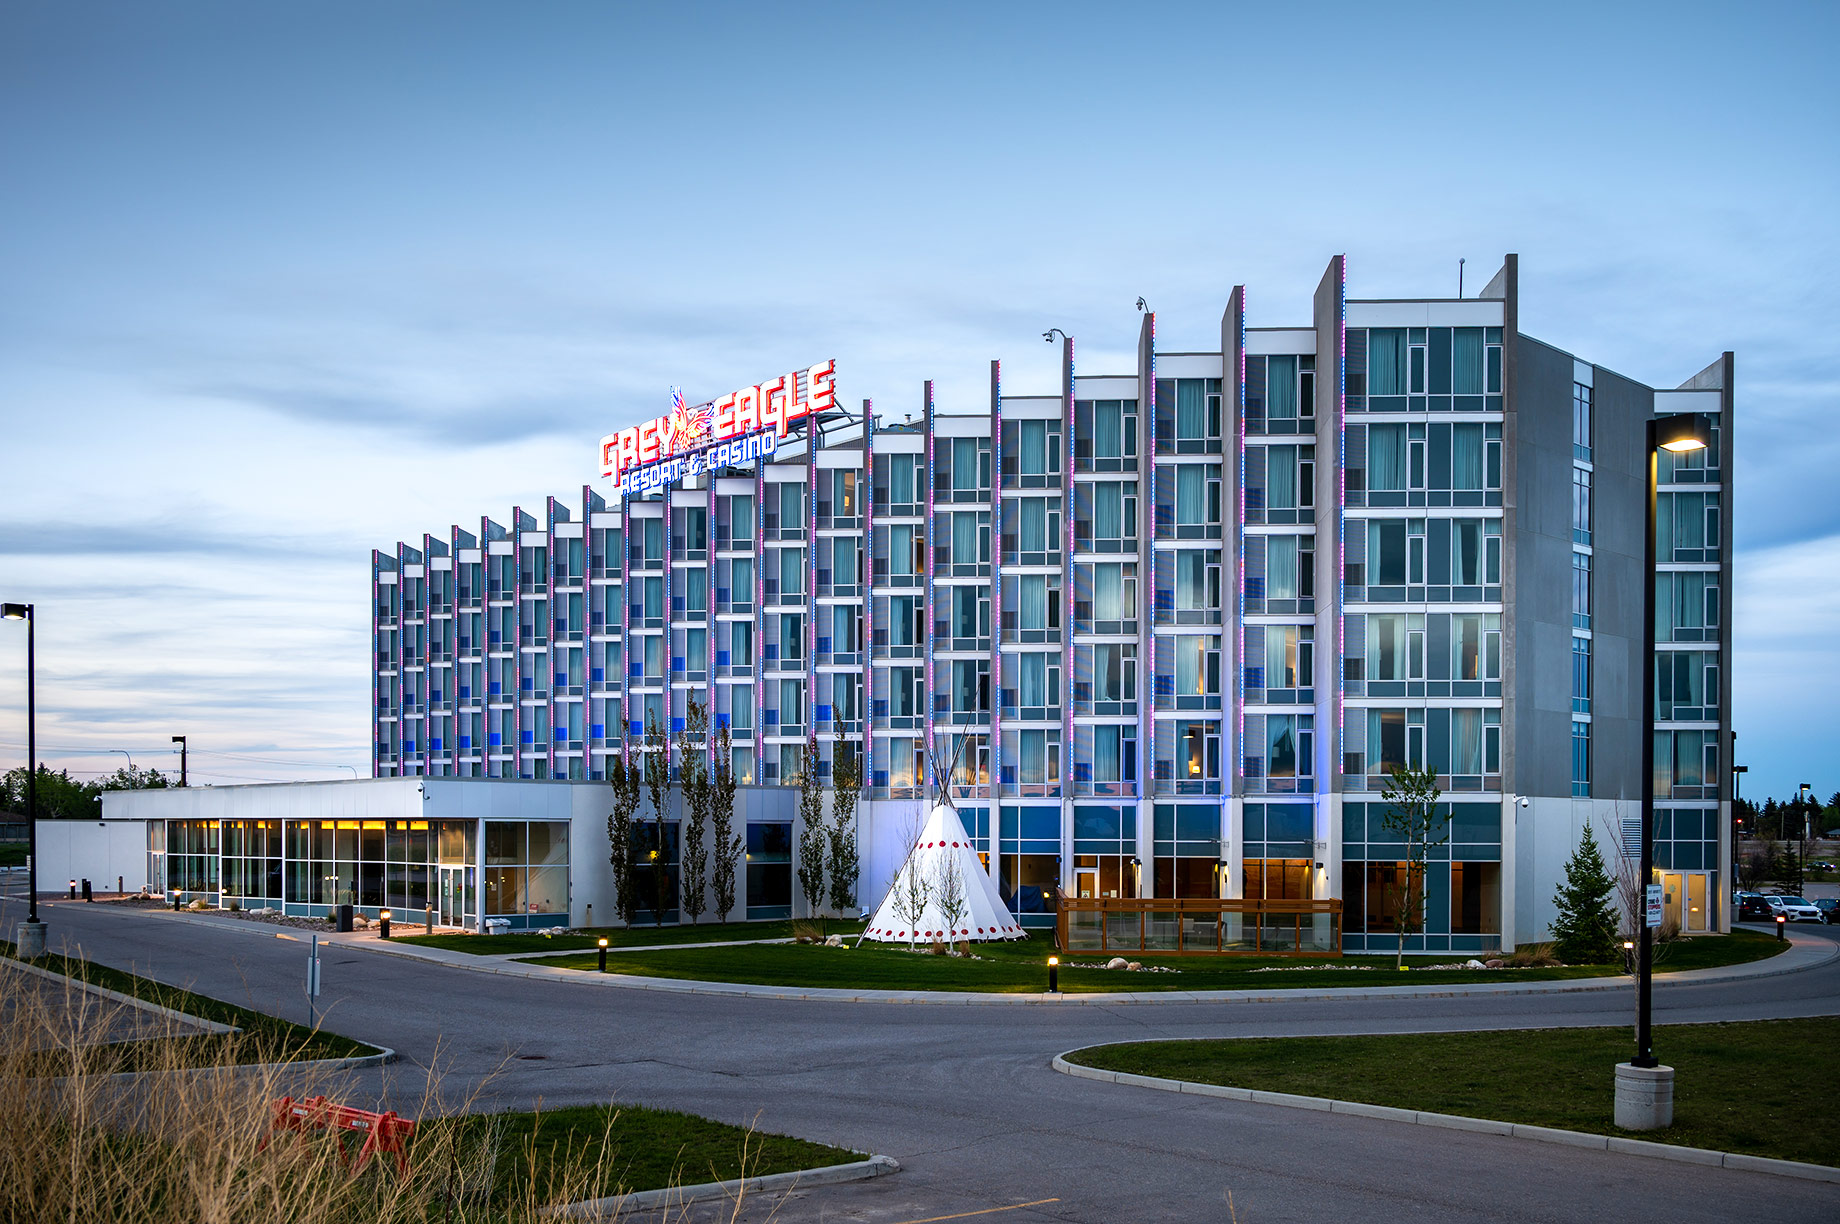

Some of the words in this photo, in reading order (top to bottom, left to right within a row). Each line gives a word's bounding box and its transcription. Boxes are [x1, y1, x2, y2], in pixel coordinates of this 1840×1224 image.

[599, 413, 677, 487] GREY
[713, 360, 834, 440] EAGLE
[620, 459, 683, 496] RESORT
[690, 455, 702, 476] &
[707, 431, 778, 470] CASINO
